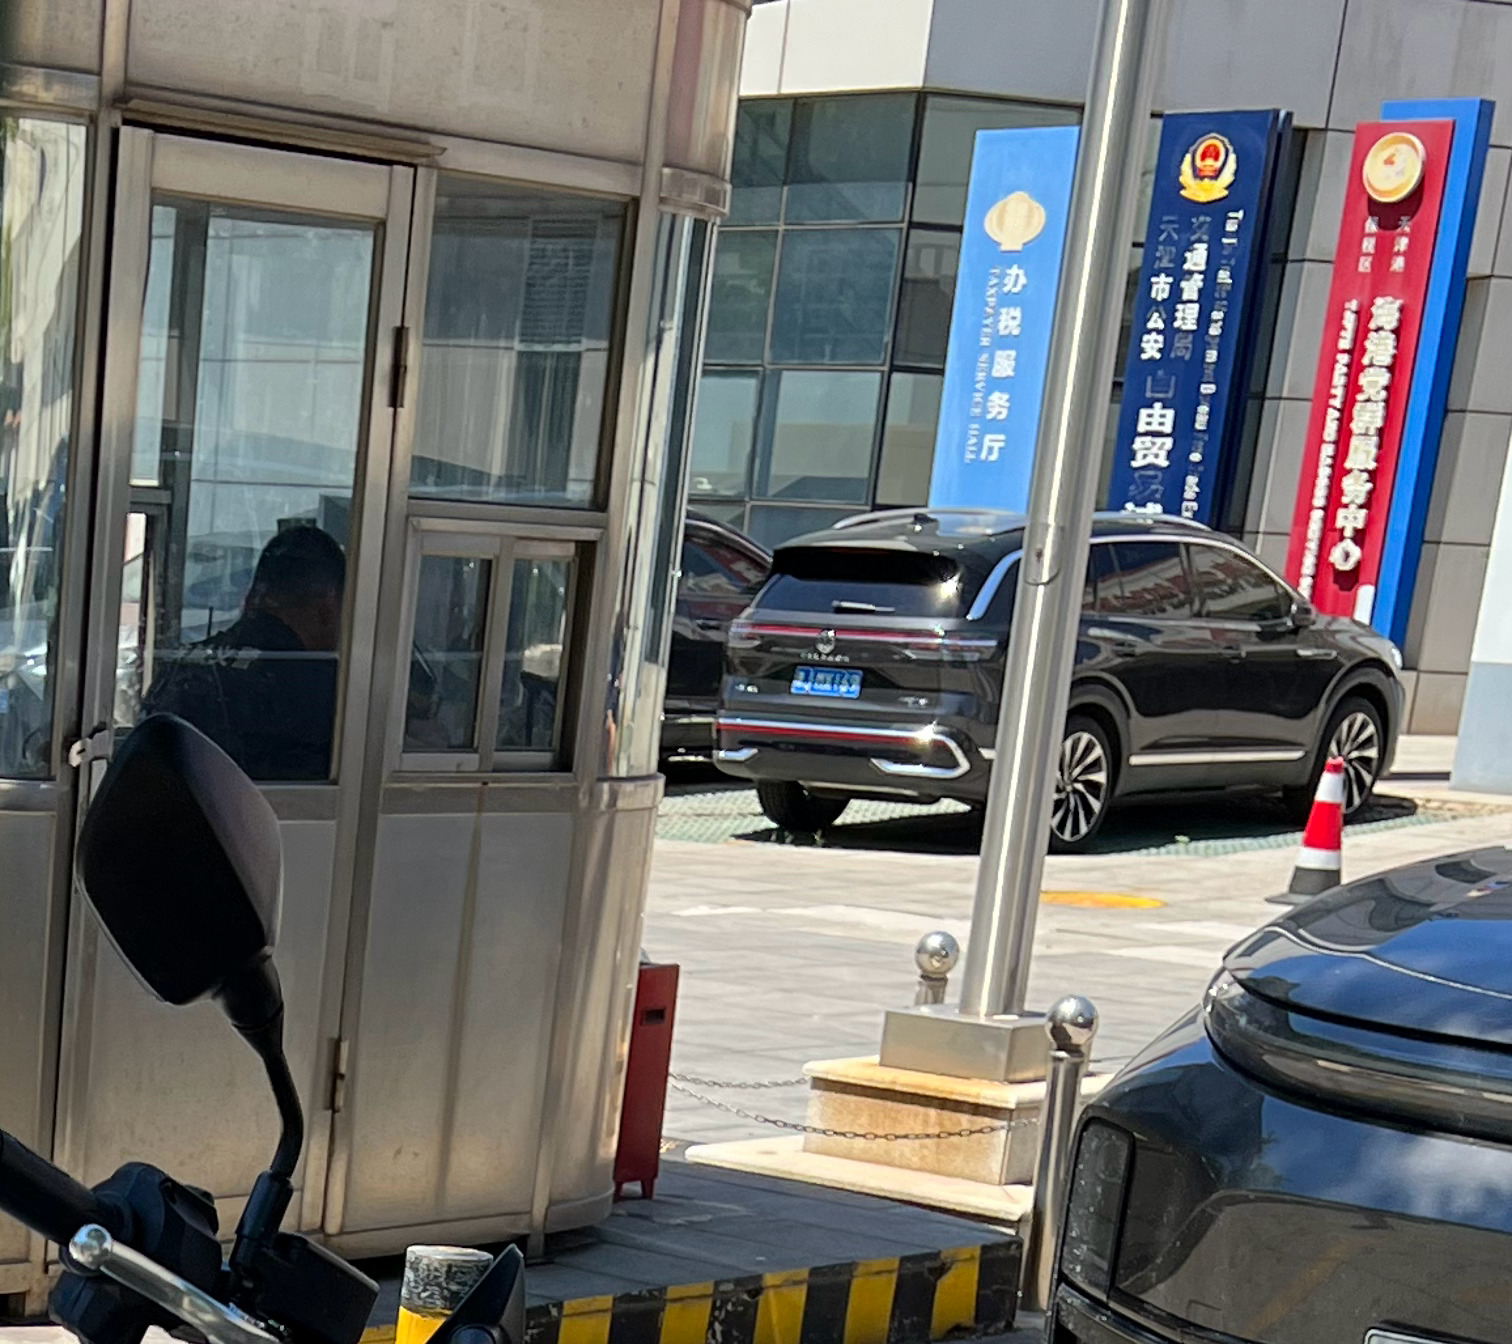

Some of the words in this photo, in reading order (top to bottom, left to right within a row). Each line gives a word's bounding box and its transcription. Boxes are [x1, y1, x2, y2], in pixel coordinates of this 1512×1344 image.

[979, 264, 1028, 462] 办税服务厅
